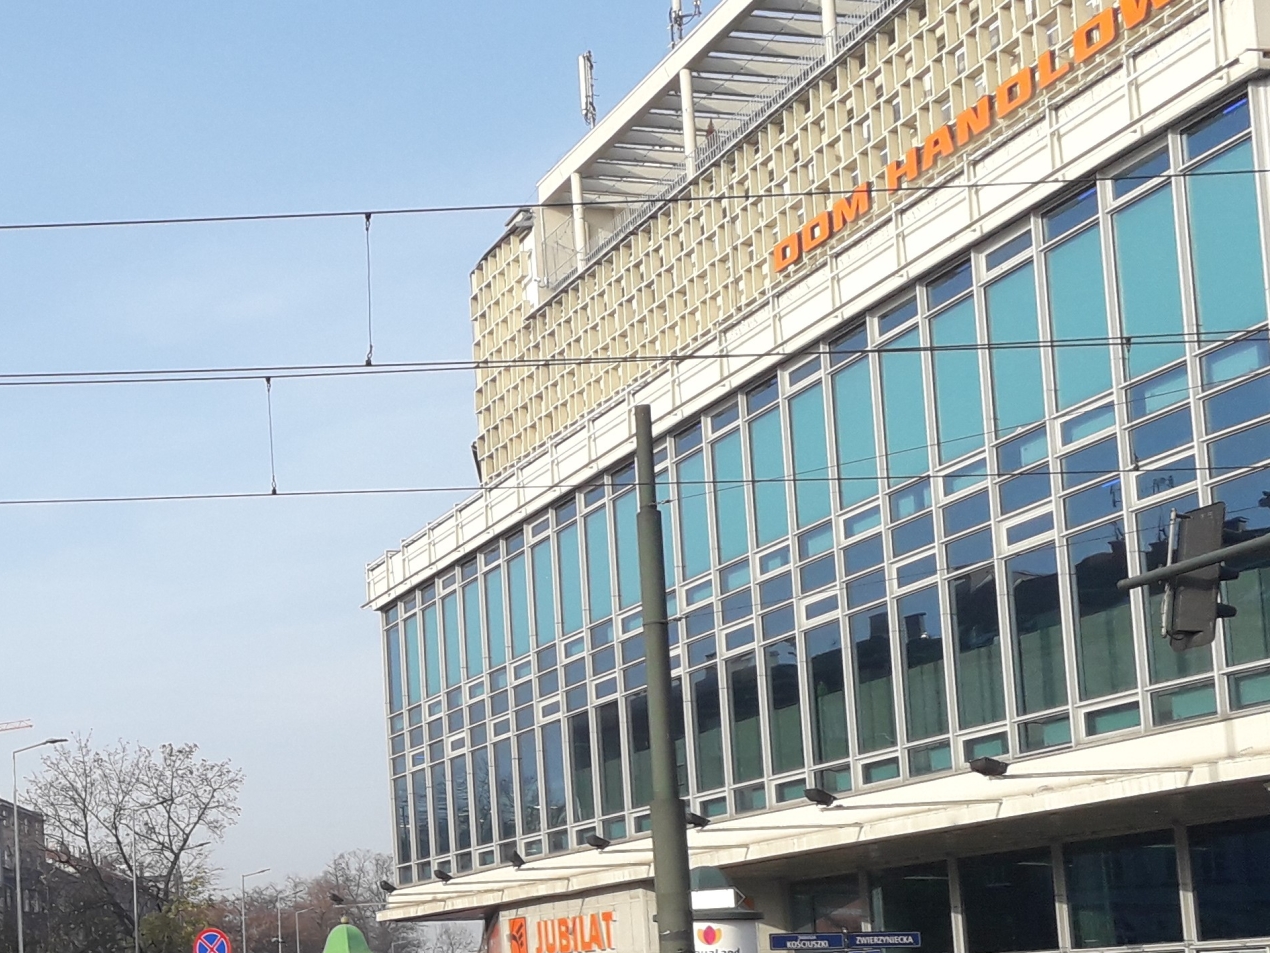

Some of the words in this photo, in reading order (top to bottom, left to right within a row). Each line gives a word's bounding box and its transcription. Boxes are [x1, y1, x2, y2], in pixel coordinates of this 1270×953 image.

[773, 181, 871, 273] DOM
[786, 939, 829, 949] KOŚCIUSZKI
[856, 935, 914, 944] ZWIERZYNIECKA
